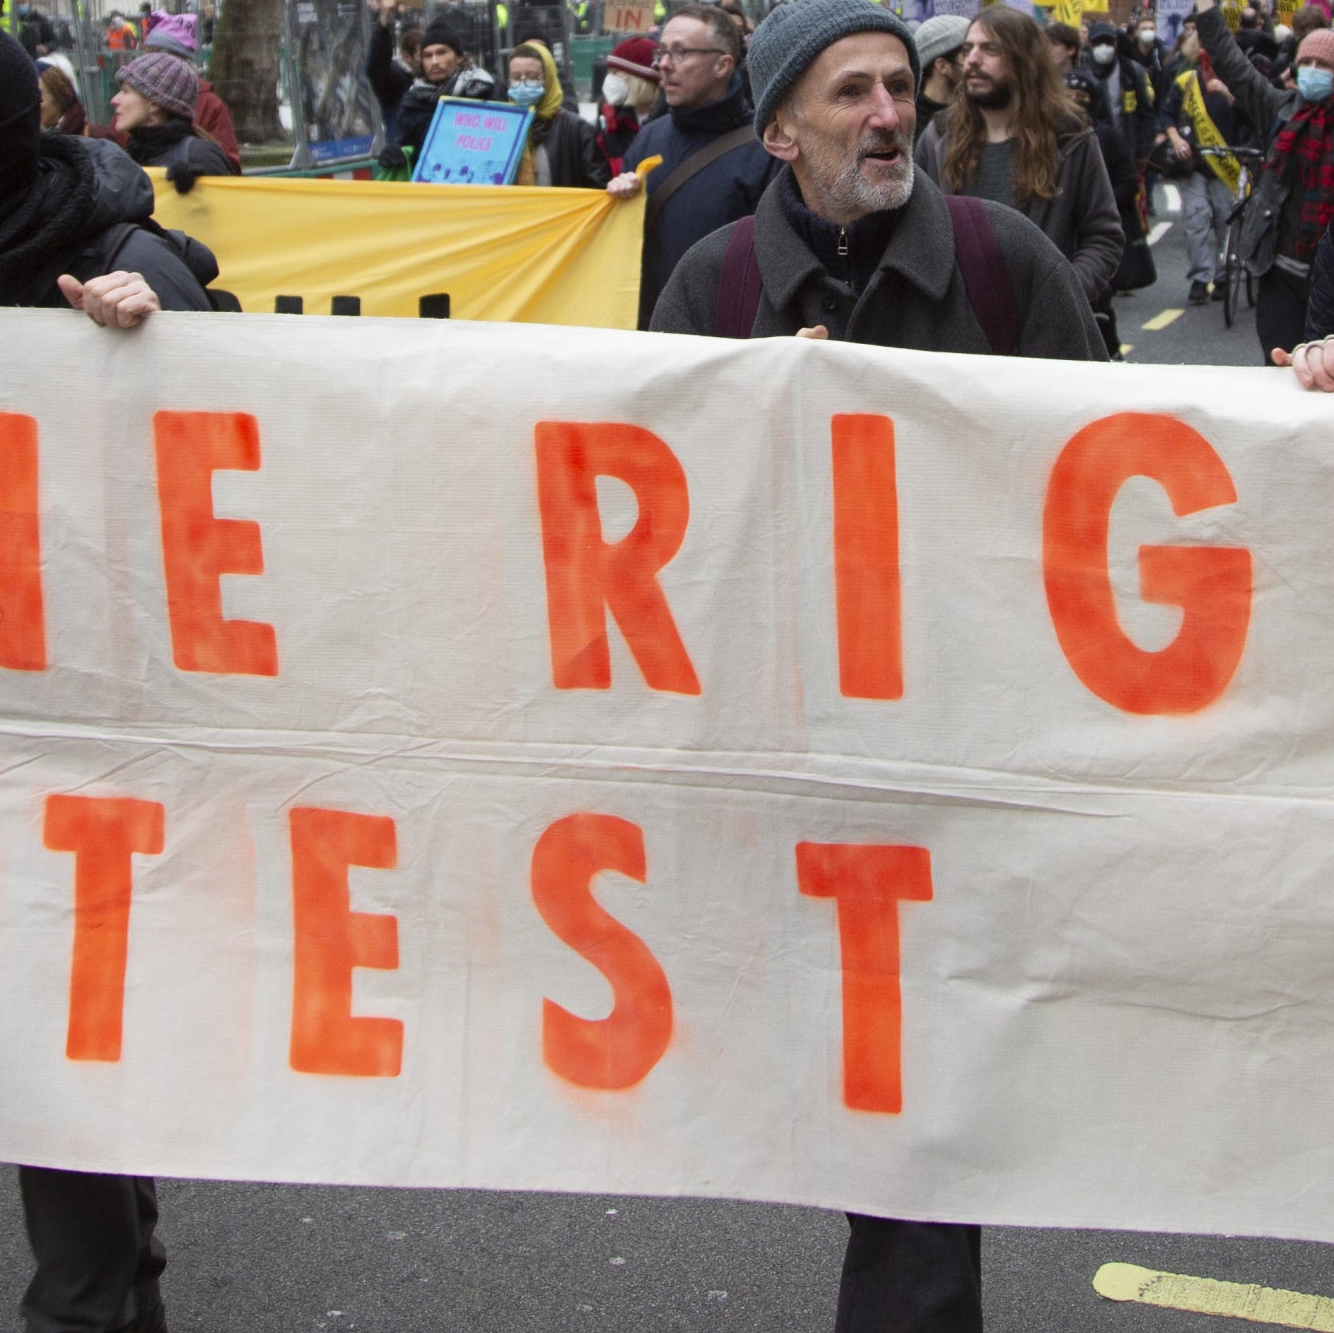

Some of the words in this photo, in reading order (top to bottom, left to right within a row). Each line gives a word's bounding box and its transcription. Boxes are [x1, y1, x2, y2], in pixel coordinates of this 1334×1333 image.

[615, 8, 643, 30] IN
[453, 111, 481, 129] WHO
[483, 114, 509, 133] WILL
[455, 133, 494, 153] POLICE
